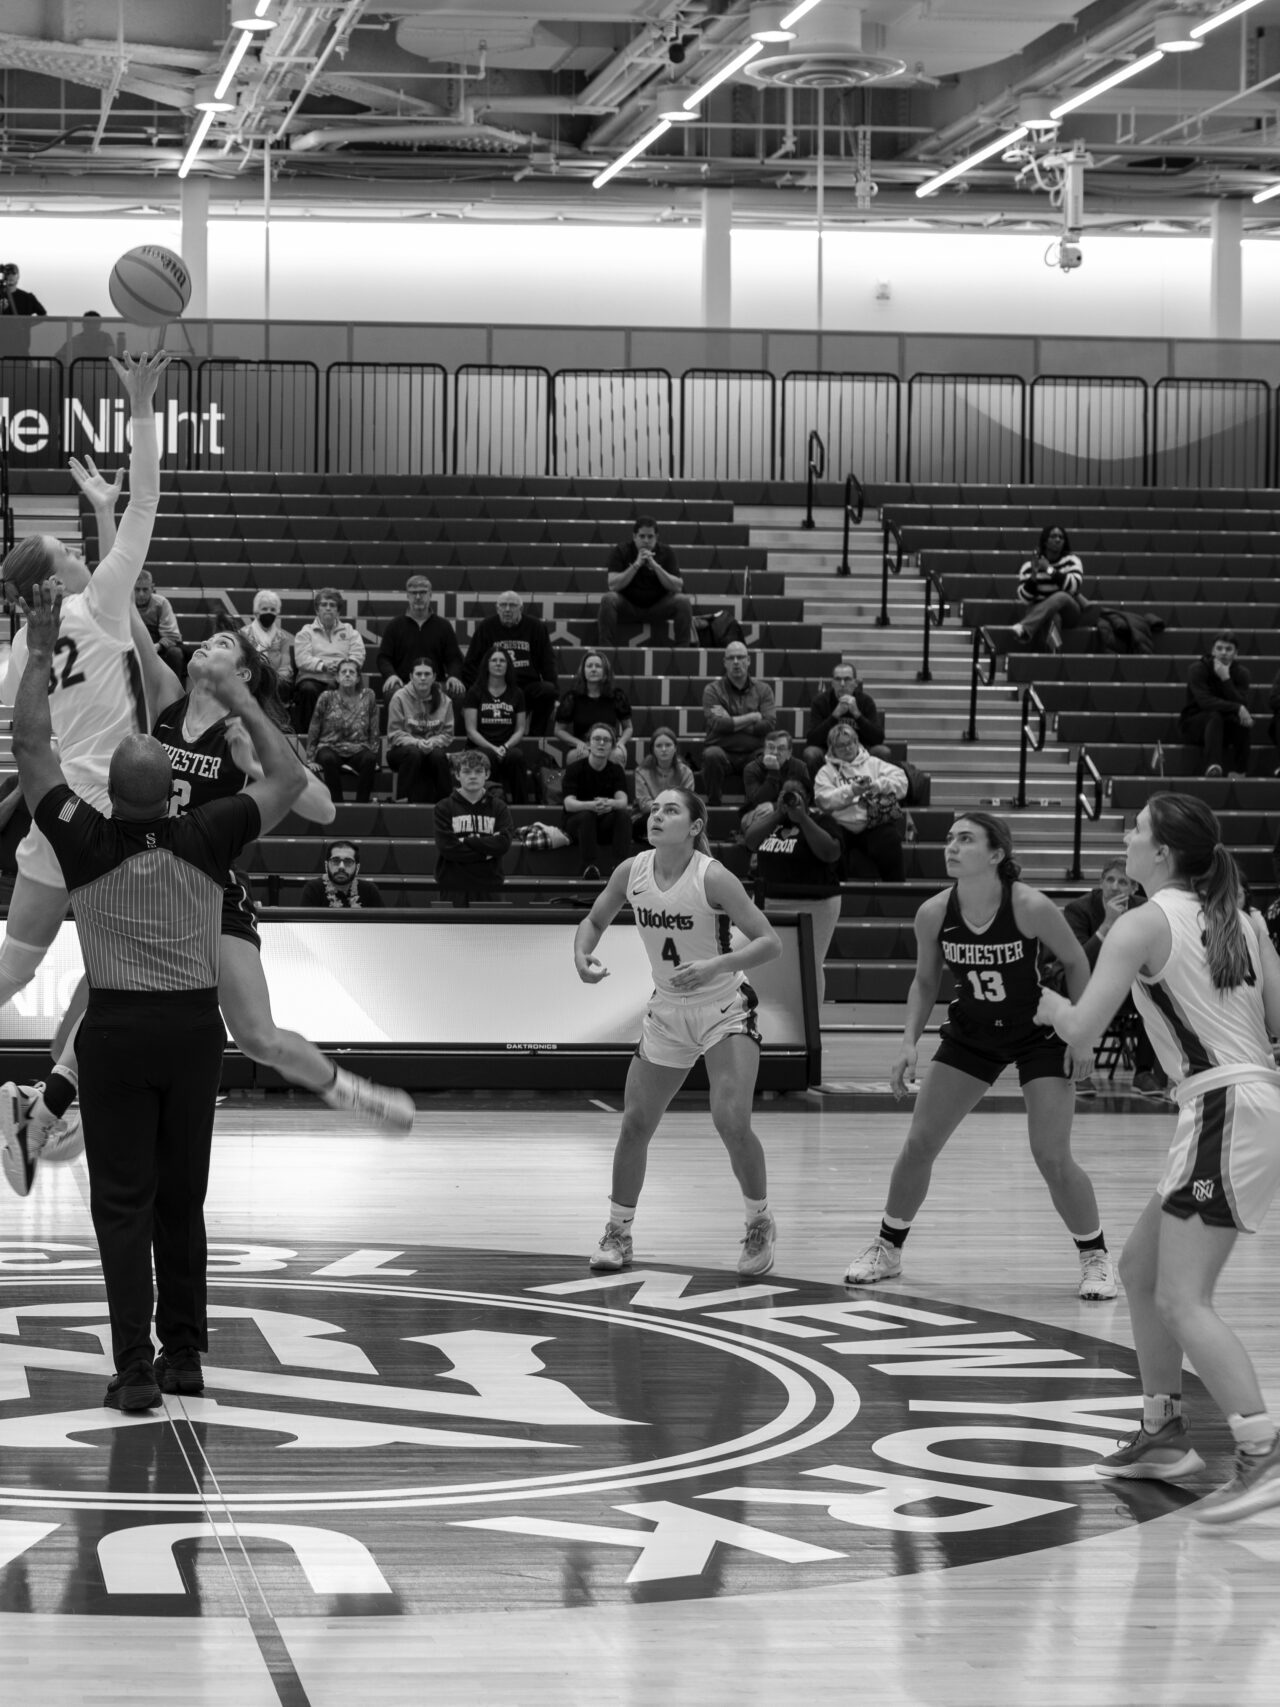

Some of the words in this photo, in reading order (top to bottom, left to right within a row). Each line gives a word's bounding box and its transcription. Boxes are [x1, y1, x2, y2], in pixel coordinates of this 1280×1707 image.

[48, 636, 86, 695] 2
[636, 906, 695, 931] Violets
[661, 937, 681, 967] 4
[942, 938, 1025, 966] ROCHESTER
[967, 969, 1008, 1003] 13
